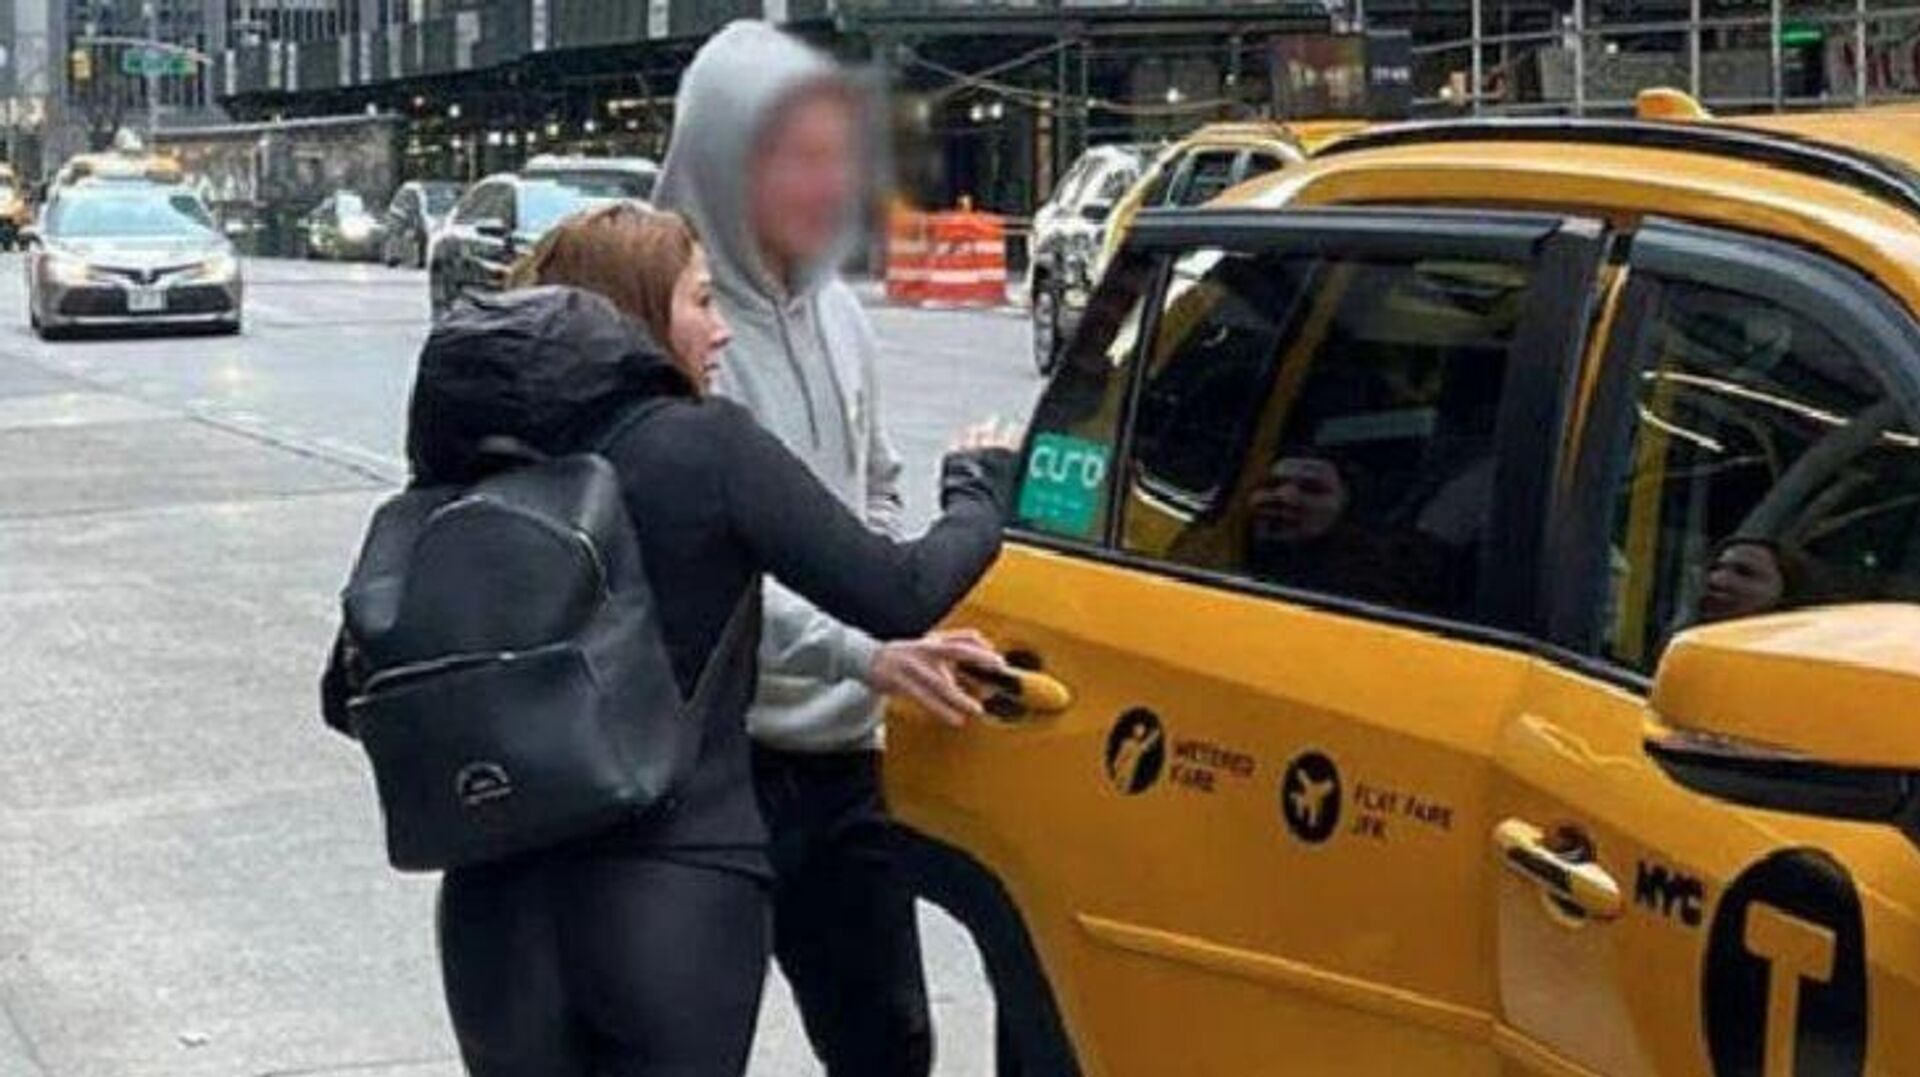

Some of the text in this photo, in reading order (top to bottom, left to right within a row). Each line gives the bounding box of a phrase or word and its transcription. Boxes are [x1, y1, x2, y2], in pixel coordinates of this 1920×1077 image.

[1352, 782, 1456, 832] FLAT FARE
[1636, 859, 1704, 927] NYC
